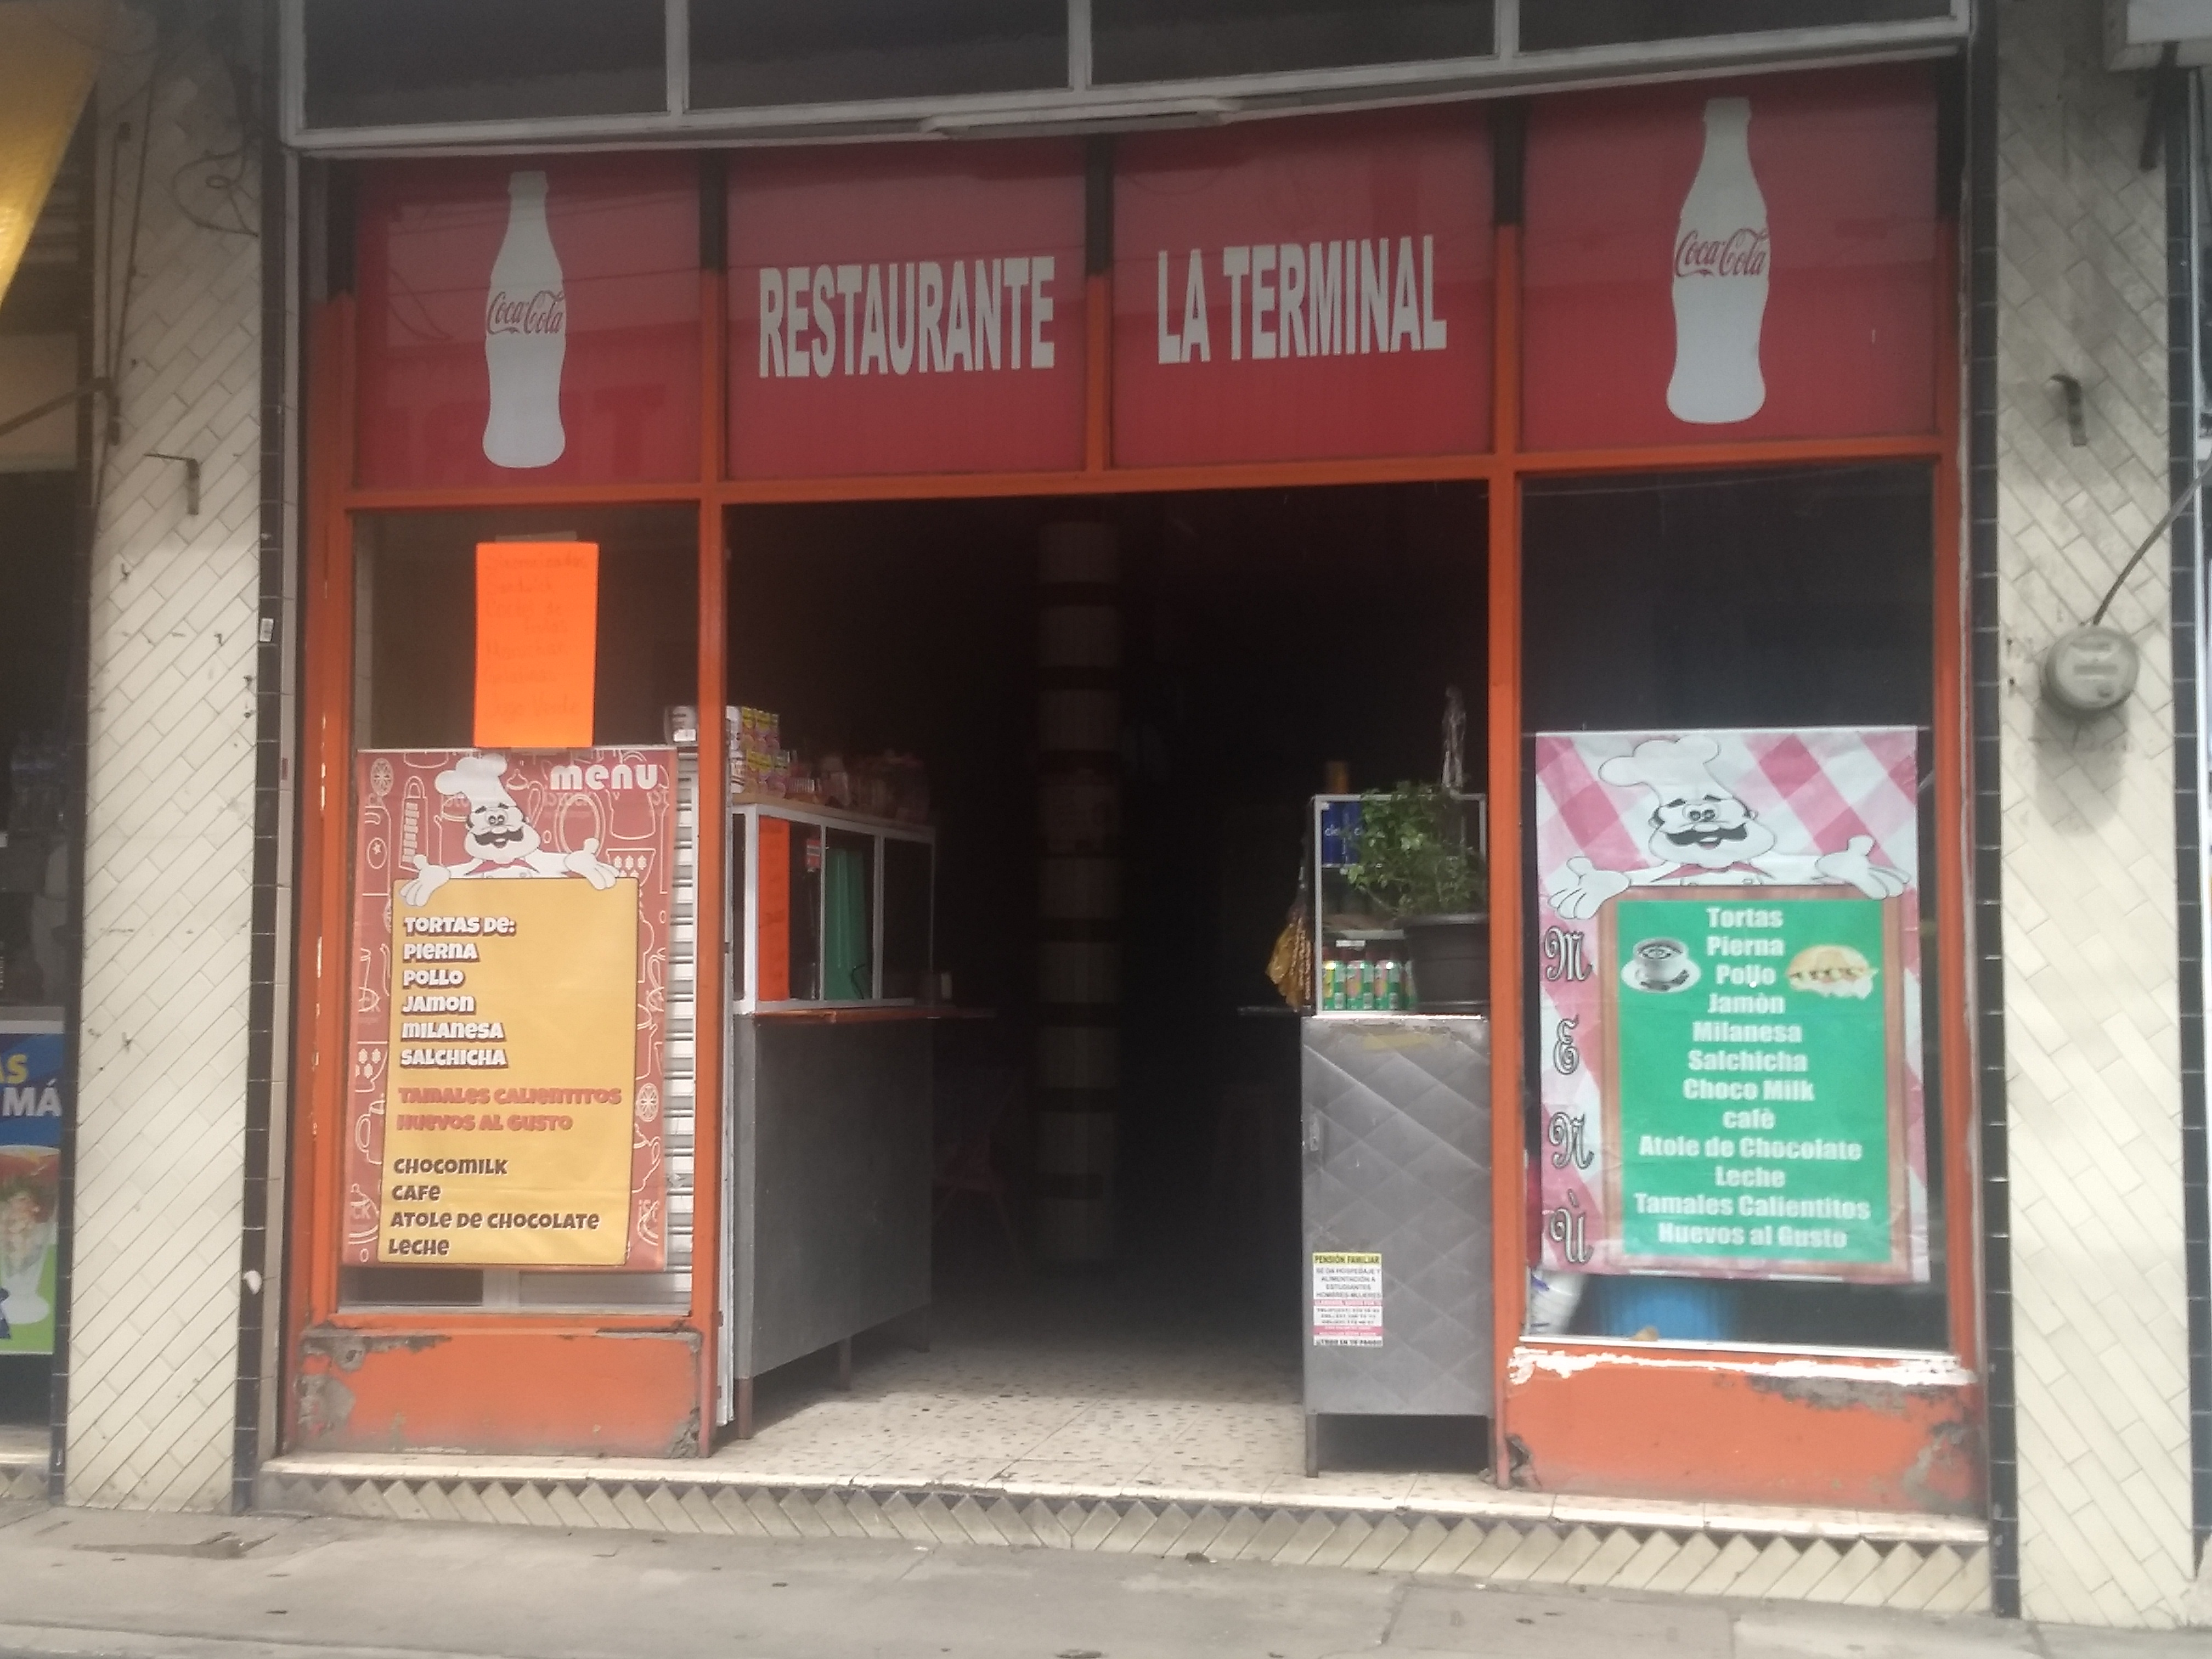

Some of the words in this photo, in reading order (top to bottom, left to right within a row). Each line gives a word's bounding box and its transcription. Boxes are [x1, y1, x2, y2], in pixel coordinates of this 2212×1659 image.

[1676, 228, 1769, 277] Coca-Cola
[1158, 248, 1211, 364] LA
[1223, 234, 1447, 361] TERMINAL
[488, 290, 565, 335] Coca-Cola
[759, 256, 1055, 378] RESTAURANTE
[404, 917, 481, 936] TORTAS
[1706, 908, 1784, 928] Tortas
[1706, 935, 1785, 956] Pierna
[403, 969, 465, 989] POLLO
[1716, 963, 1776, 986] Pollo
[1692, 1020, 1803, 1042] Milanesa
[400, 1049, 509, 1069] SALCHICHA
[1688, 1049, 1808, 1071] Salchicha
[1683, 1077, 1758, 1101] Choco
[1762, 1079, 1815, 1101] Milk
[478, 1114, 504, 1131] AL
[507, 1114, 574, 1131] GUSTO
[1639, 1135, 1700, 1156] Atole
[1704, 1136, 1735, 1158] de
[1739, 1137, 1864, 1160] Chocolate
[1714, 1165, 1786, 1188] Leche
[1634, 1192, 1734, 1216] Tamales
[1737, 1194, 1871, 1220] Calientitos
[1658, 1222, 1745, 1245] Huevos
[1749, 1224, 1773, 1246] al
[1777, 1224, 1848, 1249] Gusto
